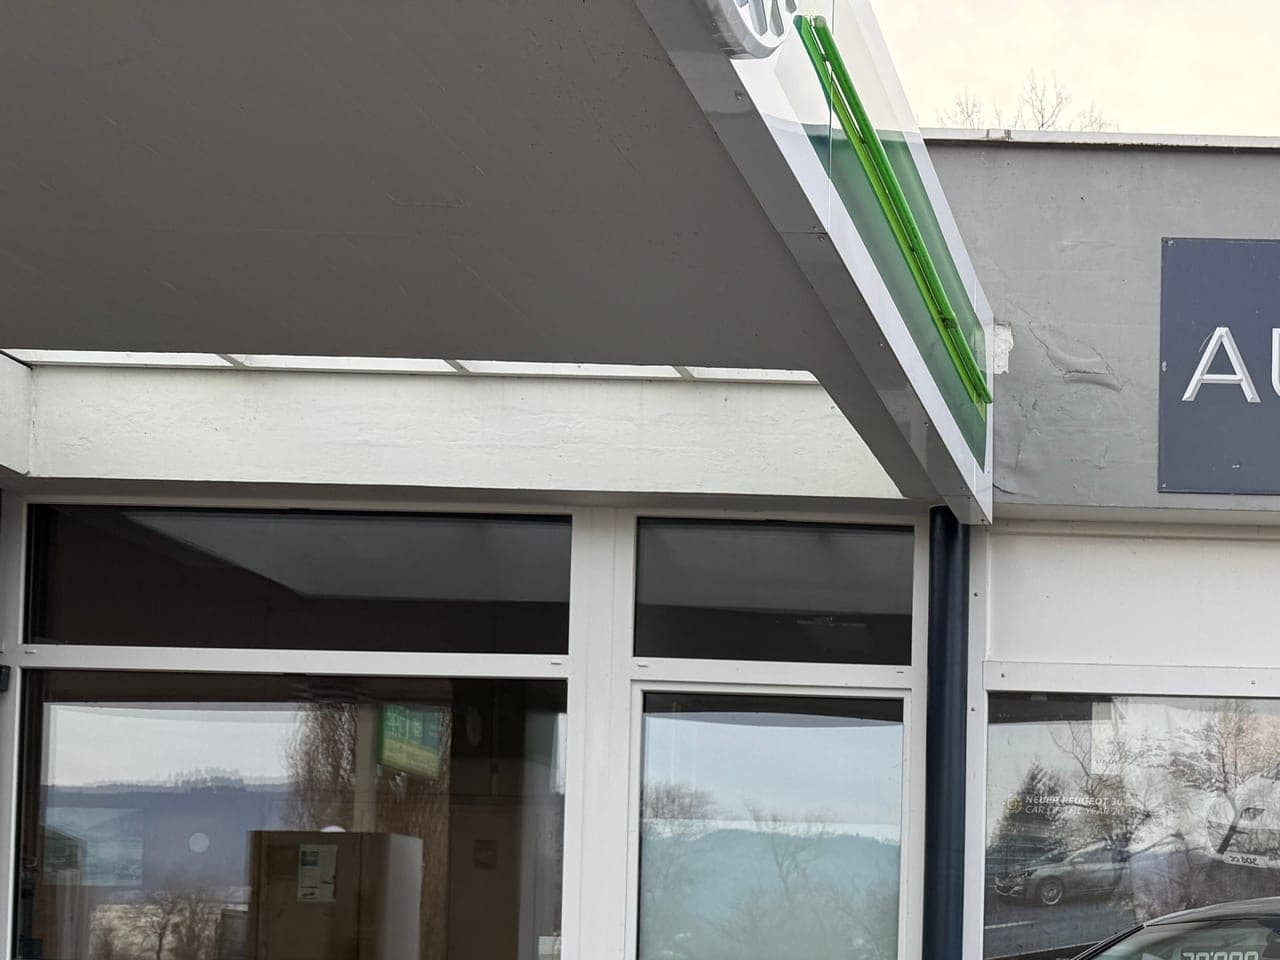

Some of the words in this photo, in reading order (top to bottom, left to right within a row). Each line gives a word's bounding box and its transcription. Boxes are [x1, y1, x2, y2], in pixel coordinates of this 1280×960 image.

[1062, 796, 1109, 807] PEUGEOT
[1025, 805, 1044, 814] CAR
[1085, 807, 1109, 816] YEAR
